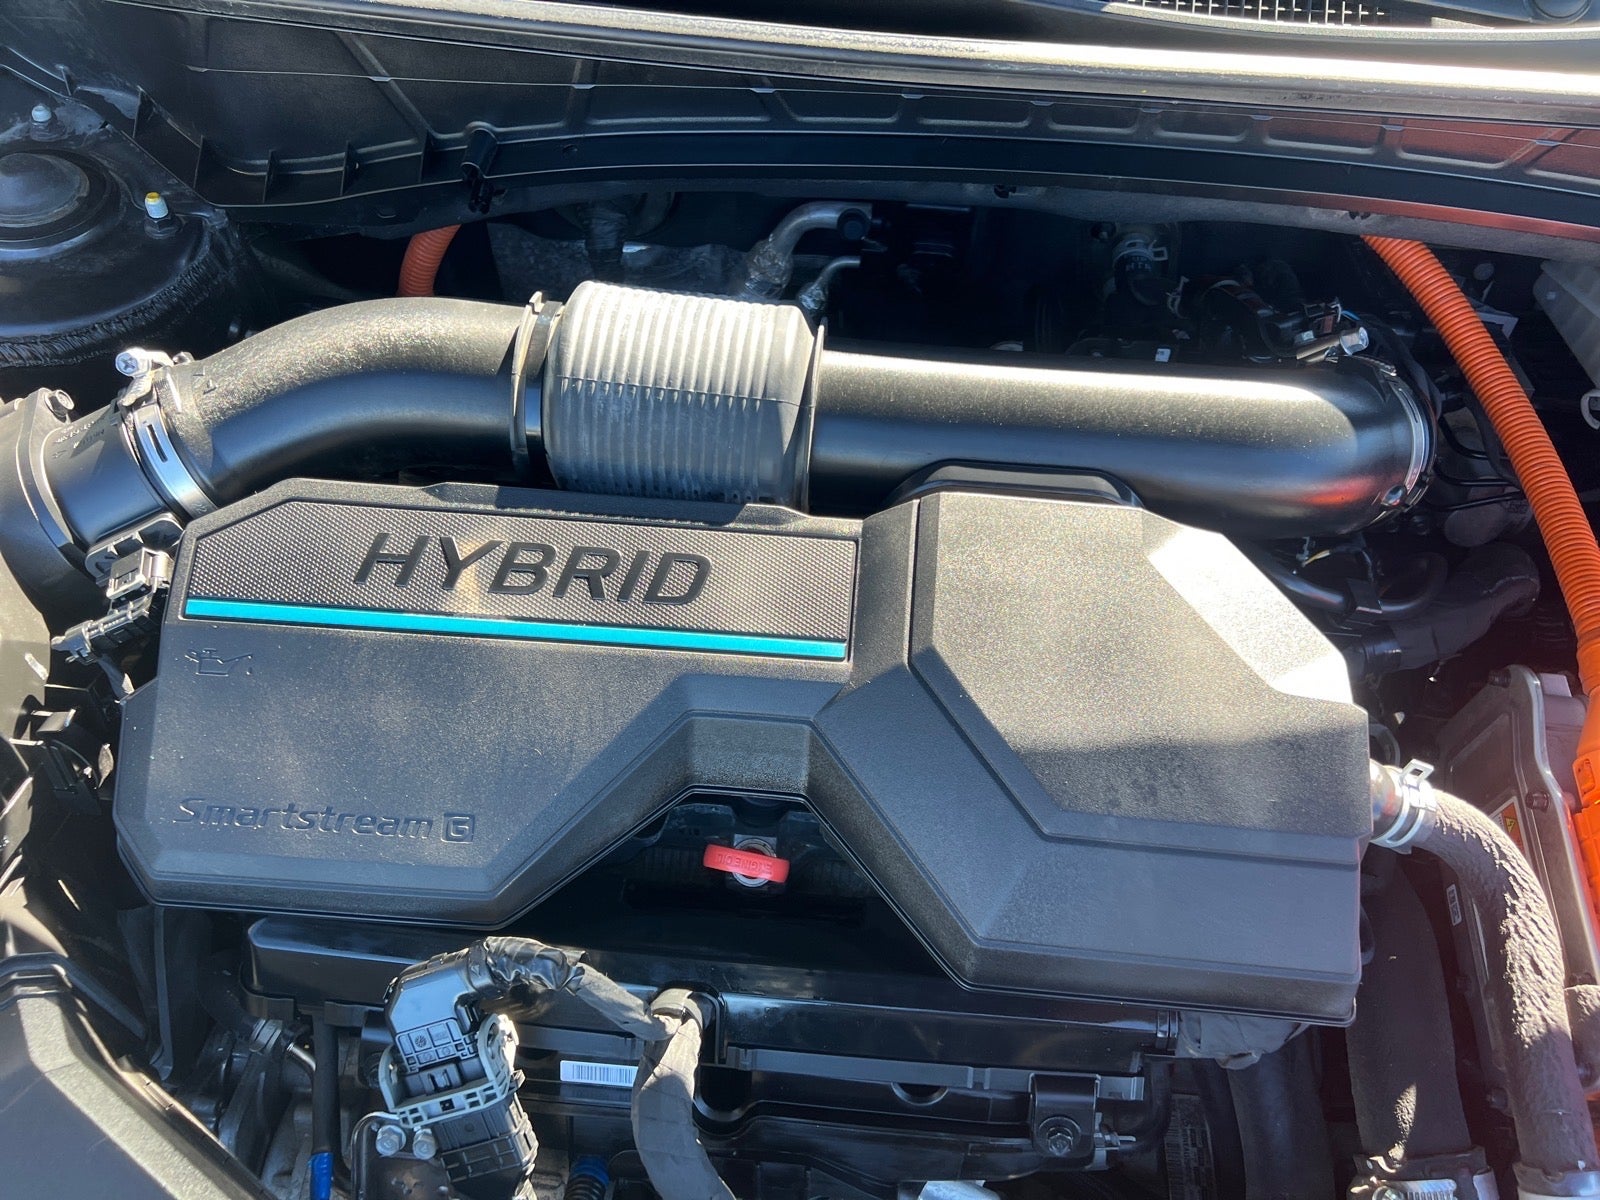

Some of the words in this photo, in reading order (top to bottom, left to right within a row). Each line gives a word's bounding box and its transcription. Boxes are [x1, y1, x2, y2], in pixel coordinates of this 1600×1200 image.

[355, 531, 710, 606] HYBRID
[173, 798, 433, 839] Smartstream
[445, 813, 474, 841] G
[717, 854, 732, 867] OIL
[733, 858, 773, 876] ENGINE
